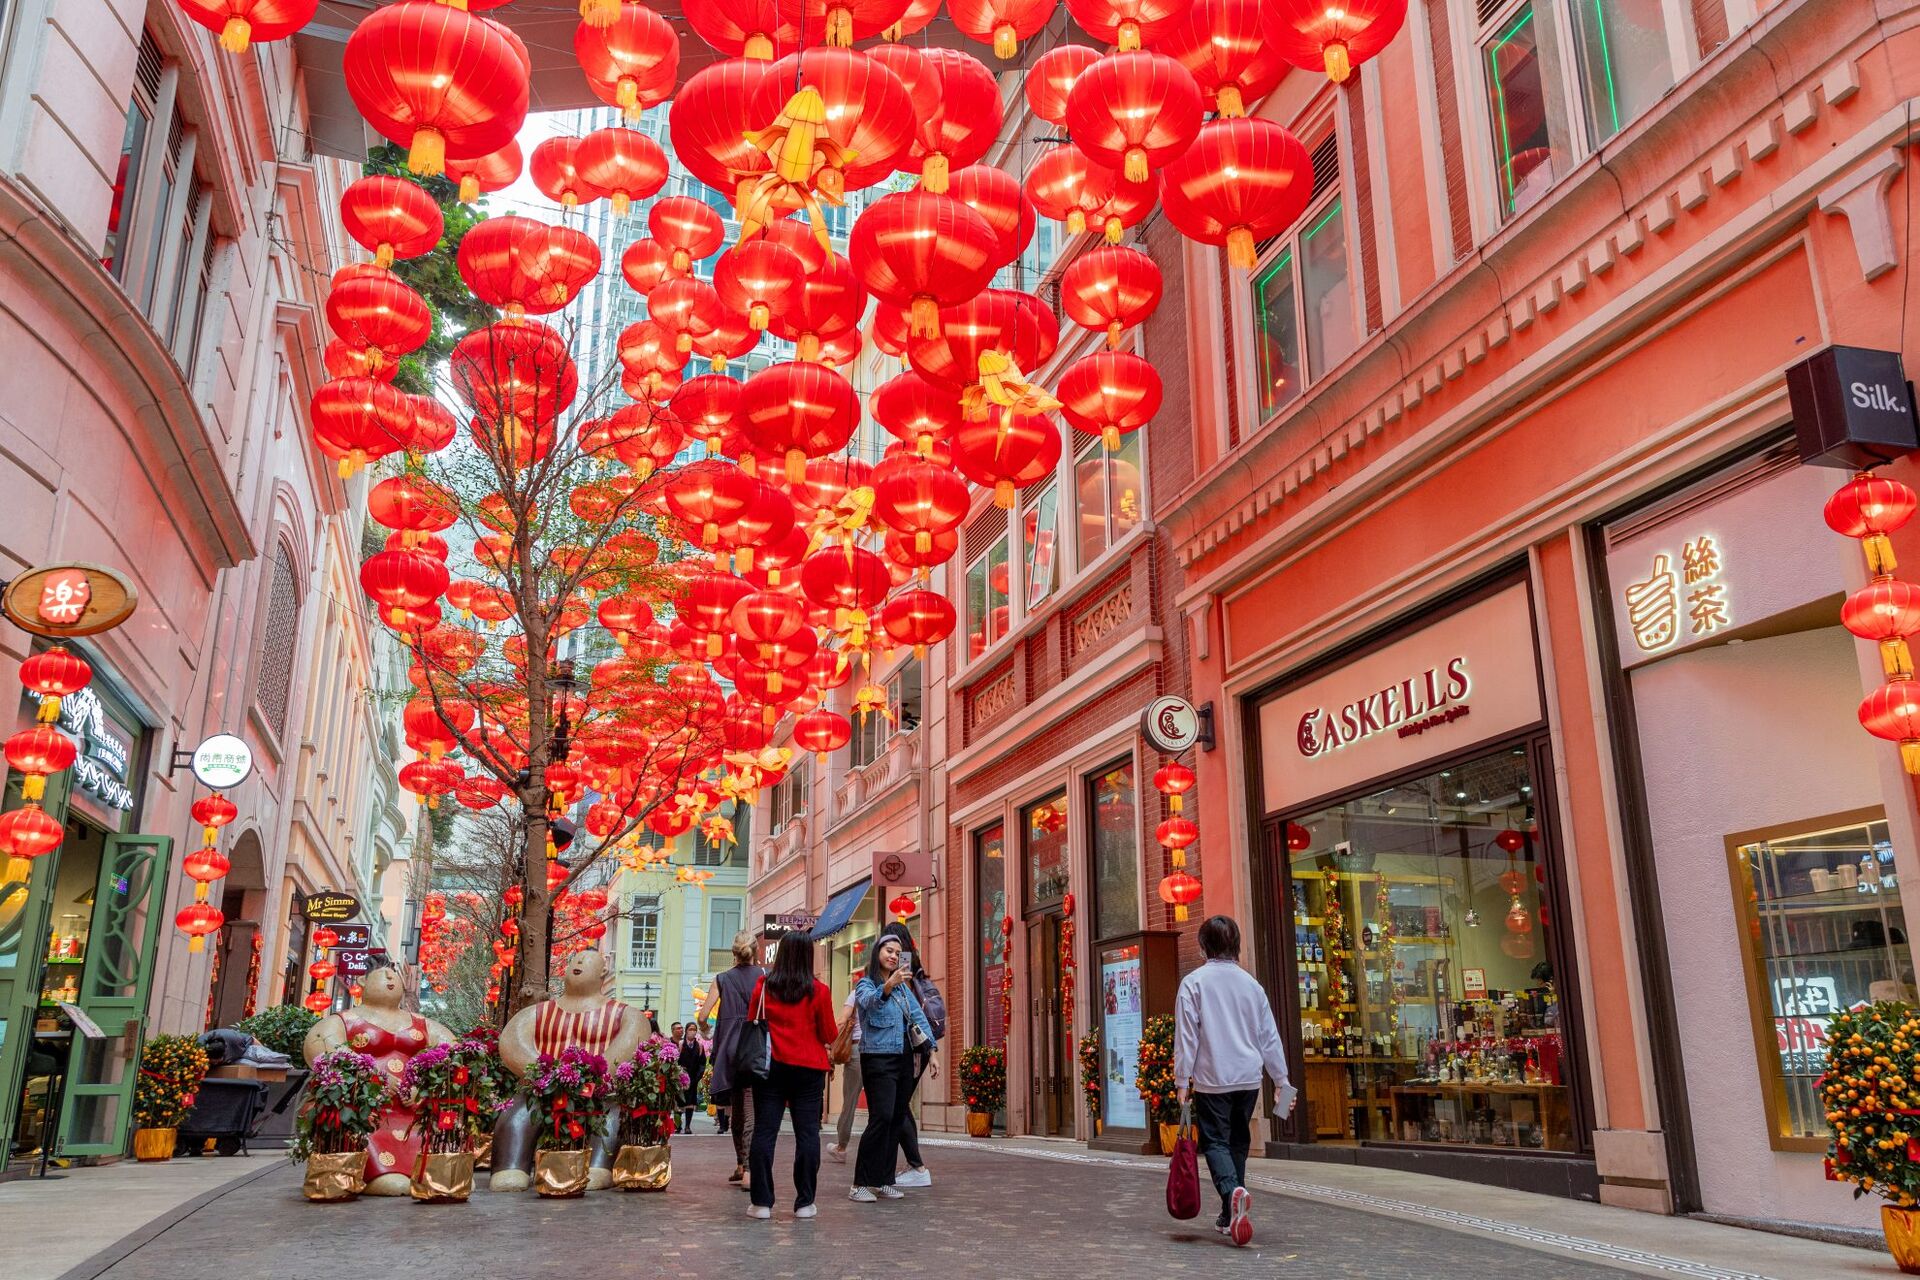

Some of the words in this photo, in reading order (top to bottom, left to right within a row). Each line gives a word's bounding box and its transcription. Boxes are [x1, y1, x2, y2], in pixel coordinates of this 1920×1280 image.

[1850, 382, 1907, 413] Silk.
[1682, 535, 1728, 634] 絲茶
[1297, 657, 1470, 757] CASKELLS
[306, 898, 323, 913] Mr
[324, 897, 355, 907] Simms
